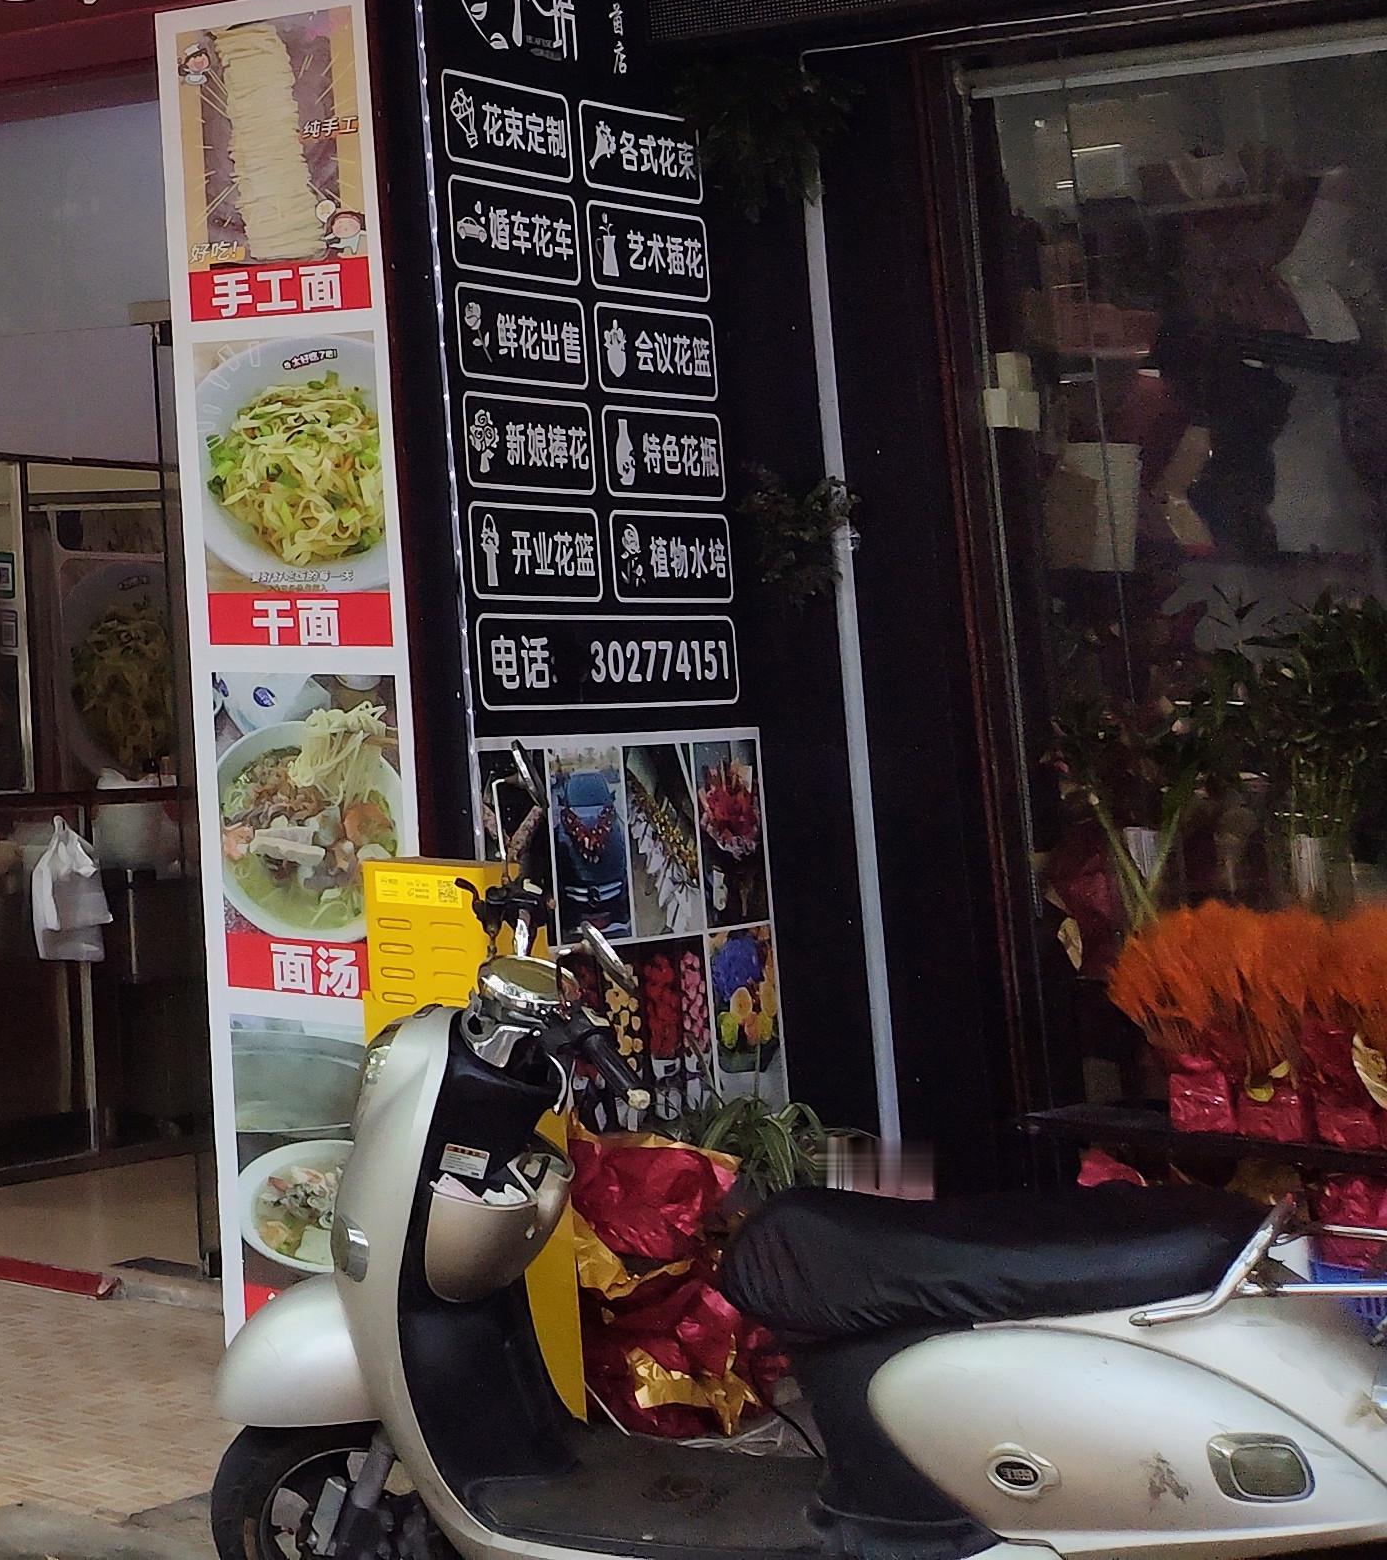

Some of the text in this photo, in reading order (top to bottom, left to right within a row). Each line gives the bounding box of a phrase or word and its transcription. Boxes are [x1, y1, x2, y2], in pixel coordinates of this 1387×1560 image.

[302, 117, 358, 140] 纯手工
[482, 102, 567, 159] 花束定制
[620, 130, 697, 181] 各式花束
[489, 207, 573, 261] 婚车花车
[627, 230, 704, 279] 艺术插花
[212, 264, 342, 318] 手工面
[496, 313, 581, 365] 鲜花出售
[635, 330, 711, 378] 会议花篮
[505, 421, 590, 470] 新娘捧花
[643, 432, 720, 478] 特色花瓶
[511, 530, 596, 577] 开业花篮
[650, 536, 727, 579] 植物水培
[253, 600, 339, 646] 干面
[590, 641, 730, 683] 302774151
[270, 942, 361, 999] 面汤
